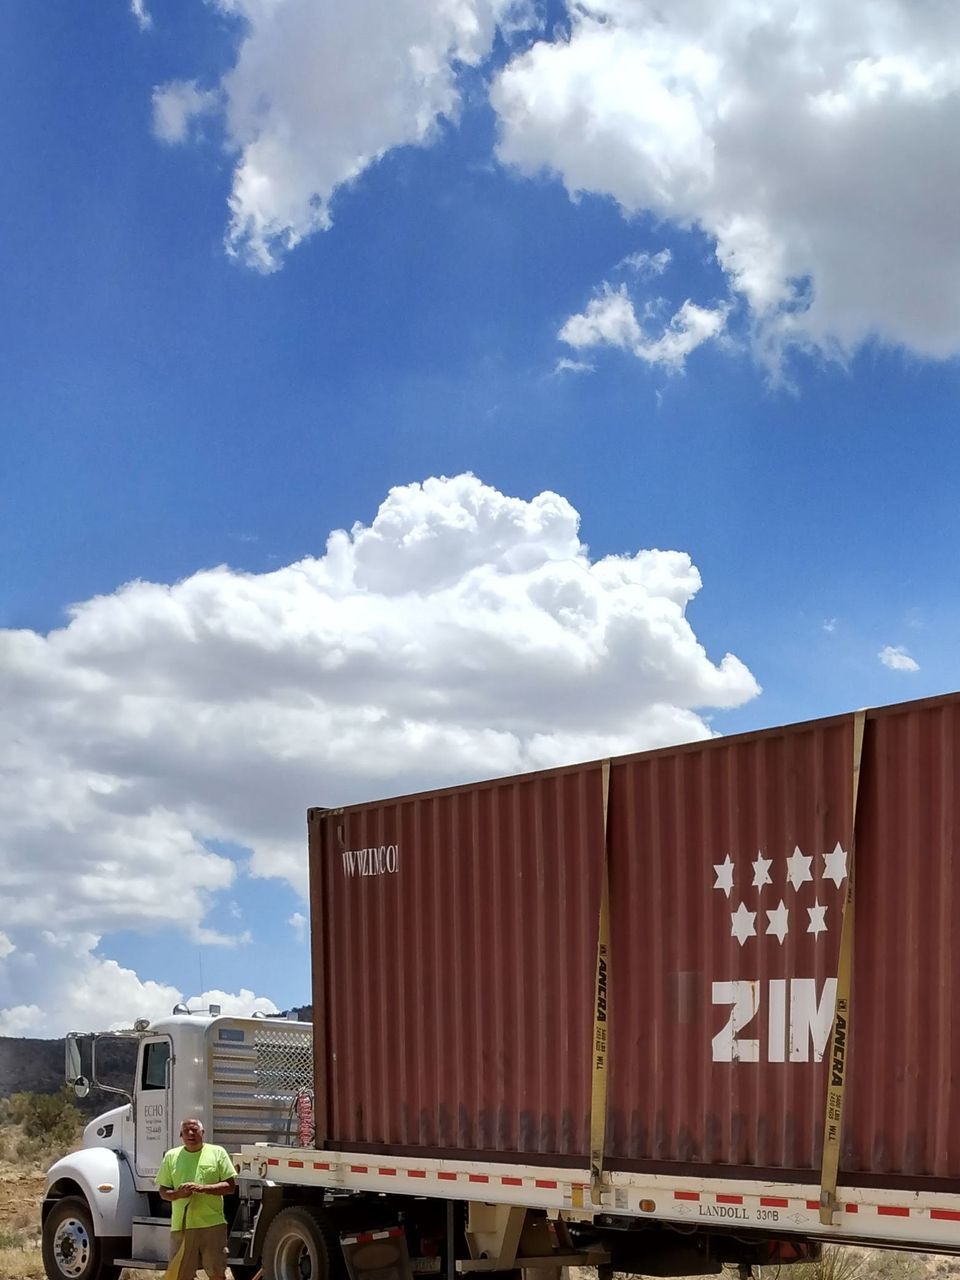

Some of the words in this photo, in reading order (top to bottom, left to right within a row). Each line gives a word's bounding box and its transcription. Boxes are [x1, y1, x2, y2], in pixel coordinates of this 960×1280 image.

[597, 957, 607, 1022] ANCRA
[711, 977, 838, 1063] ZIM
[831, 1013, 847, 1087] ANCRA
[596, 1055, 604, 1070] WLL
[144, 1104, 164, 1117] ECHO
[828, 1125, 837, 1142] WLL
[698, 1204, 750, 1220] LANDOLL
